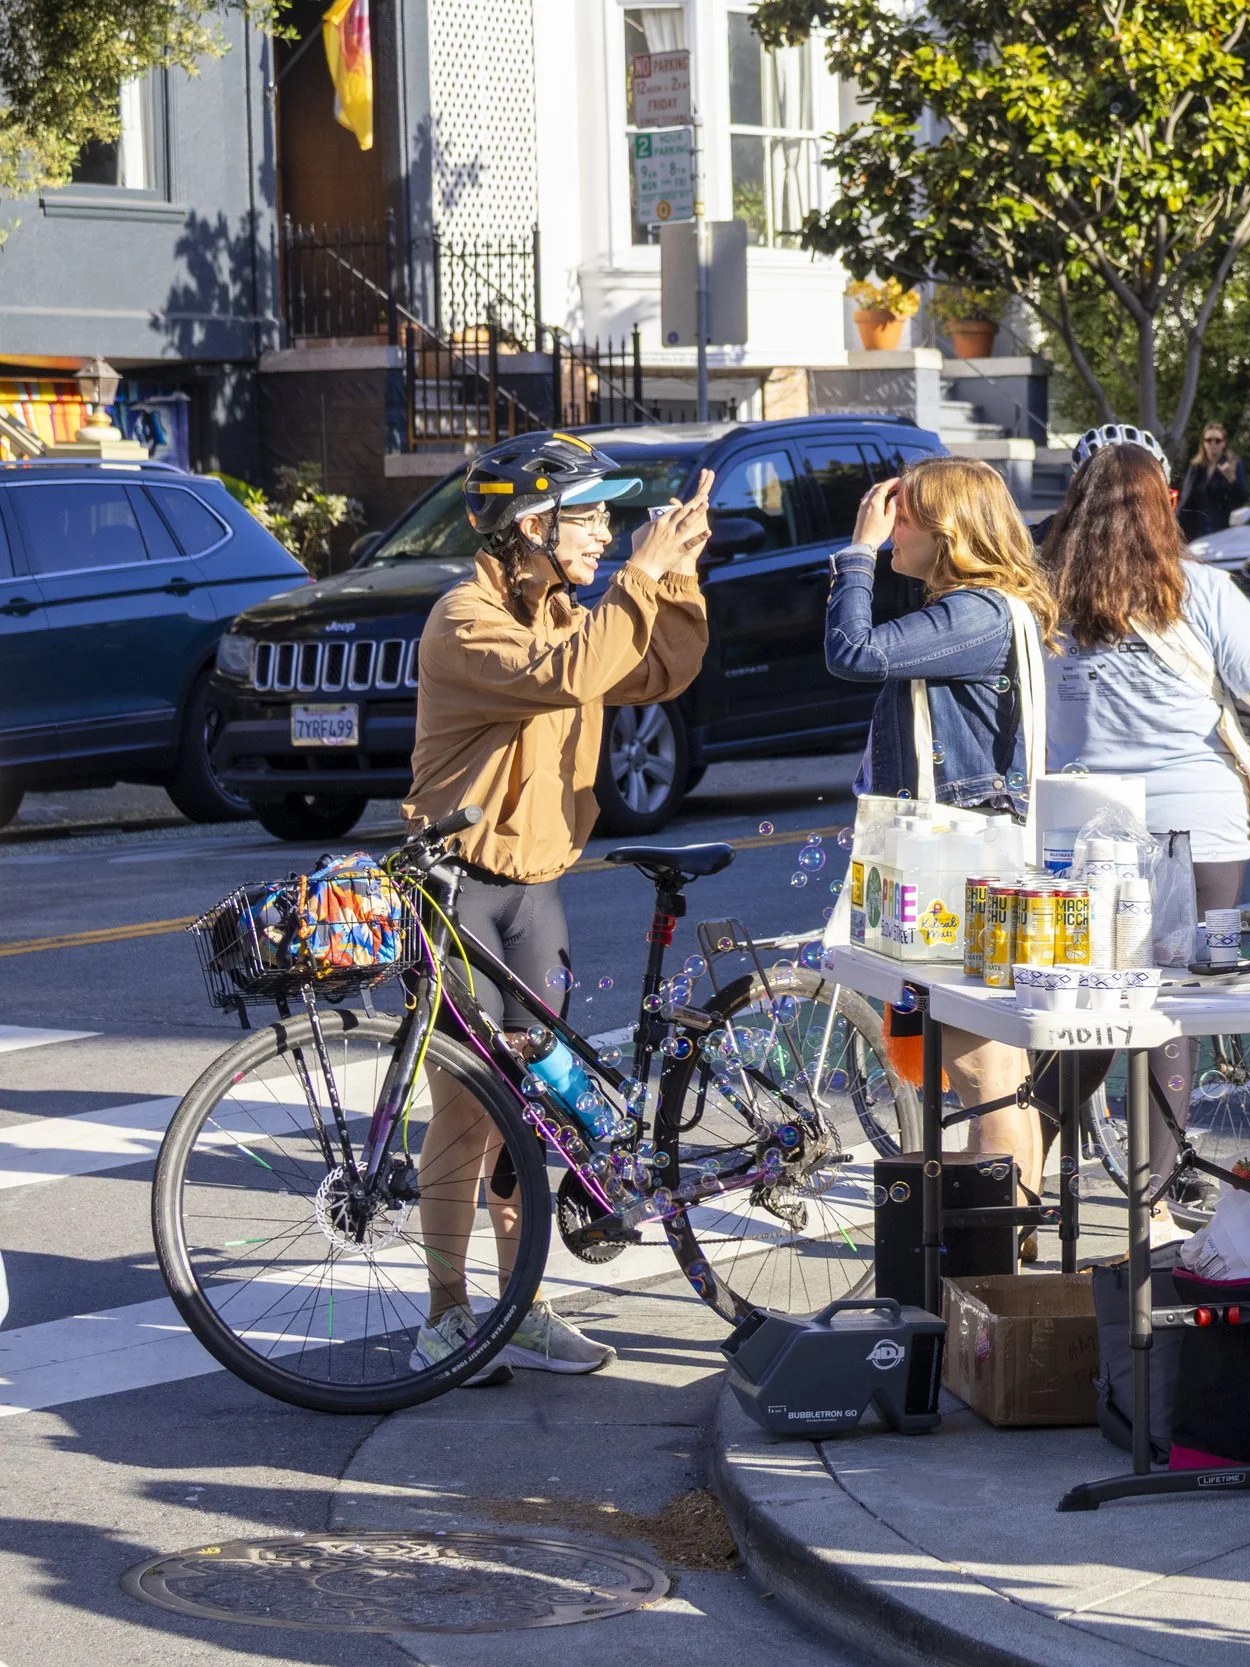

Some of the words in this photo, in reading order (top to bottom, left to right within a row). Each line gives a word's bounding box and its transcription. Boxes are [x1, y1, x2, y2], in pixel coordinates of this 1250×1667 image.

[636, 59, 649, 77] NO
[653, 57, 688, 75] PARKING
[647, 98, 678, 113] FRIDAY
[638, 137, 649, 157] 2
[659, 132, 683, 144] HOUR
[654, 144, 690, 157] PARKING
[325, 620, 356, 633] Jeep
[882, 878, 917, 922] PAGE
[788, 1410, 843, 1419] BUBBLETRON
[845, 1409, 858, 1417] GO
[1203, 1474, 1240, 1484] LIFETIME
